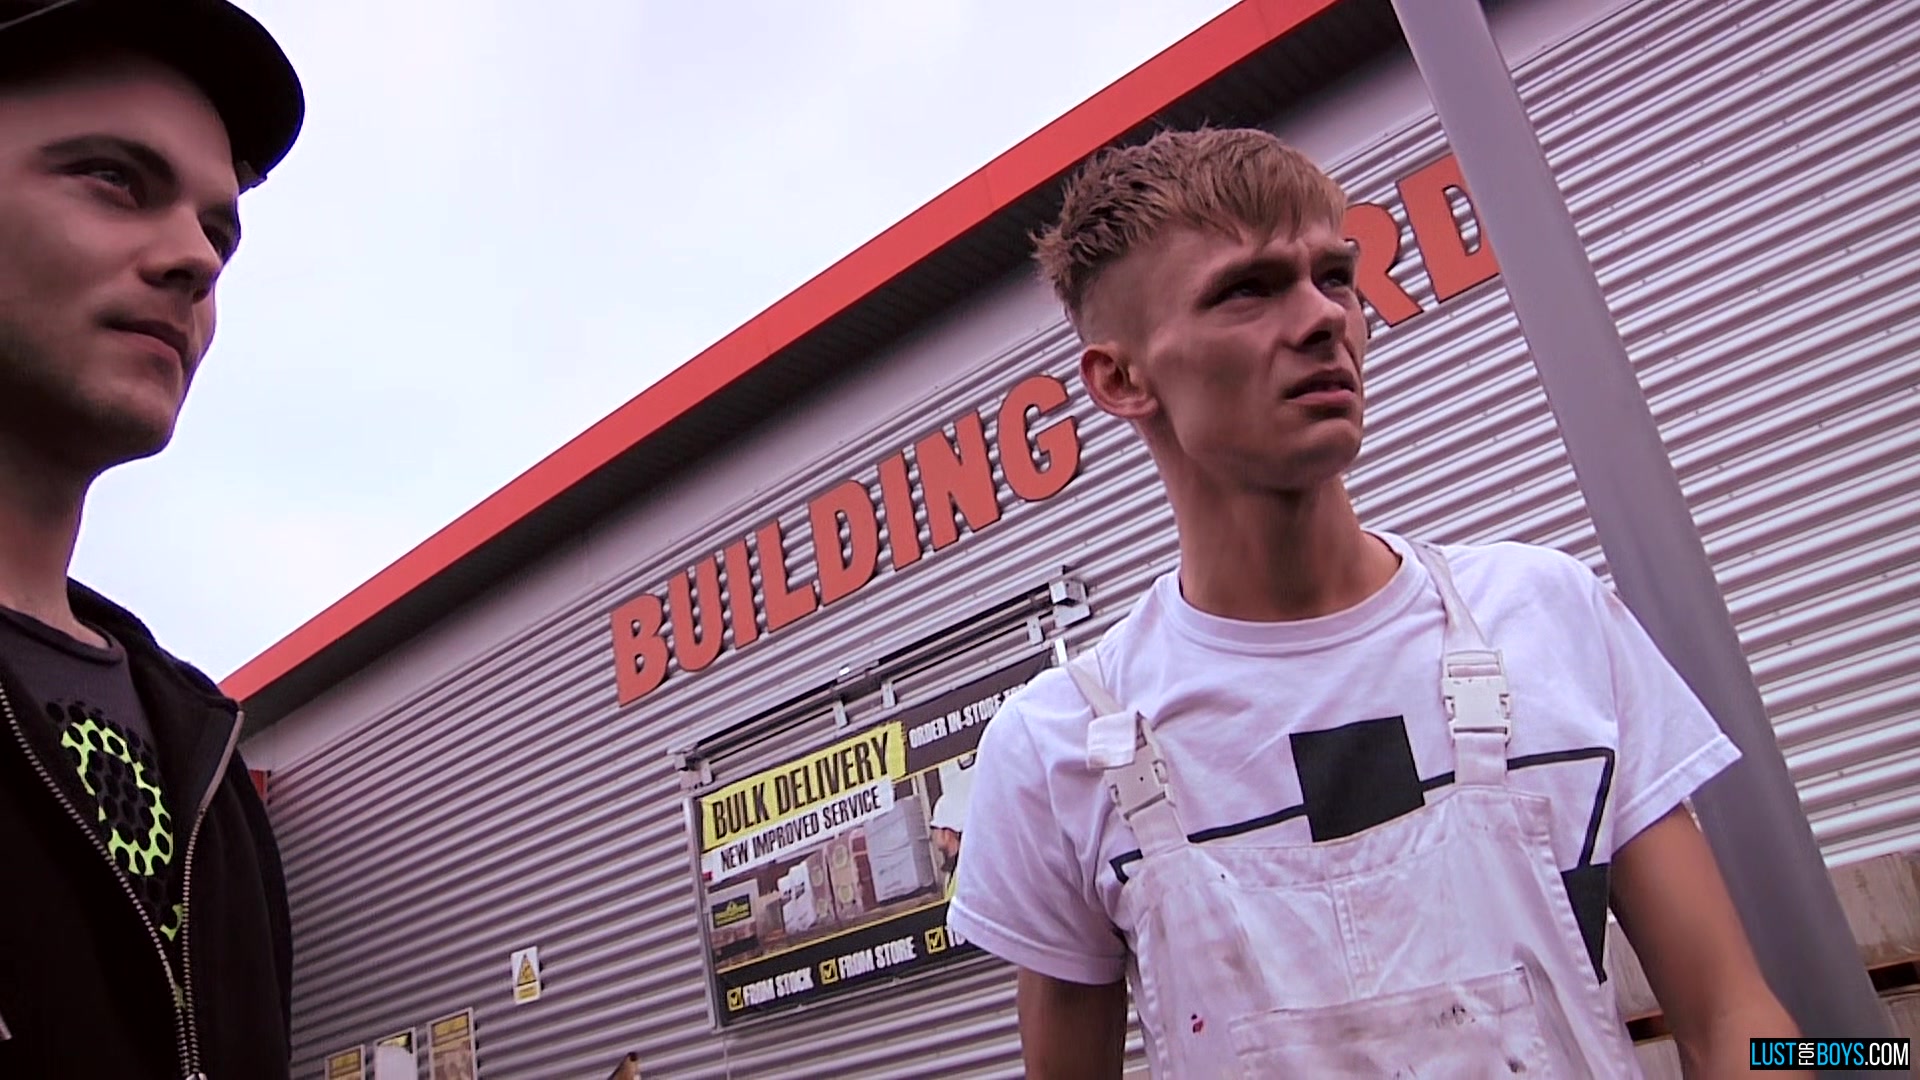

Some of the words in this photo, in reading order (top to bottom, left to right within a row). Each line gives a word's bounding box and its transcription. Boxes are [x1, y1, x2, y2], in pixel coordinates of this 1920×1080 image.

[610, 375, 1080, 708] BUILDING
[1343, 152, 1500, 330] RD
[908, 716, 948, 749] ORDER
[712, 782, 770, 840] BULK
[774, 732, 889, 816] DELIVERY
[720, 842, 749, 872] NEW
[752, 812, 820, 859] IMPROVED
[822, 785, 882, 830] SERVICE
[742, 977, 776, 1007] FROM
[775, 966, 814, 998] STOCK
[838, 951, 875, 979] FROM
[875, 936, 917, 969] STORE
